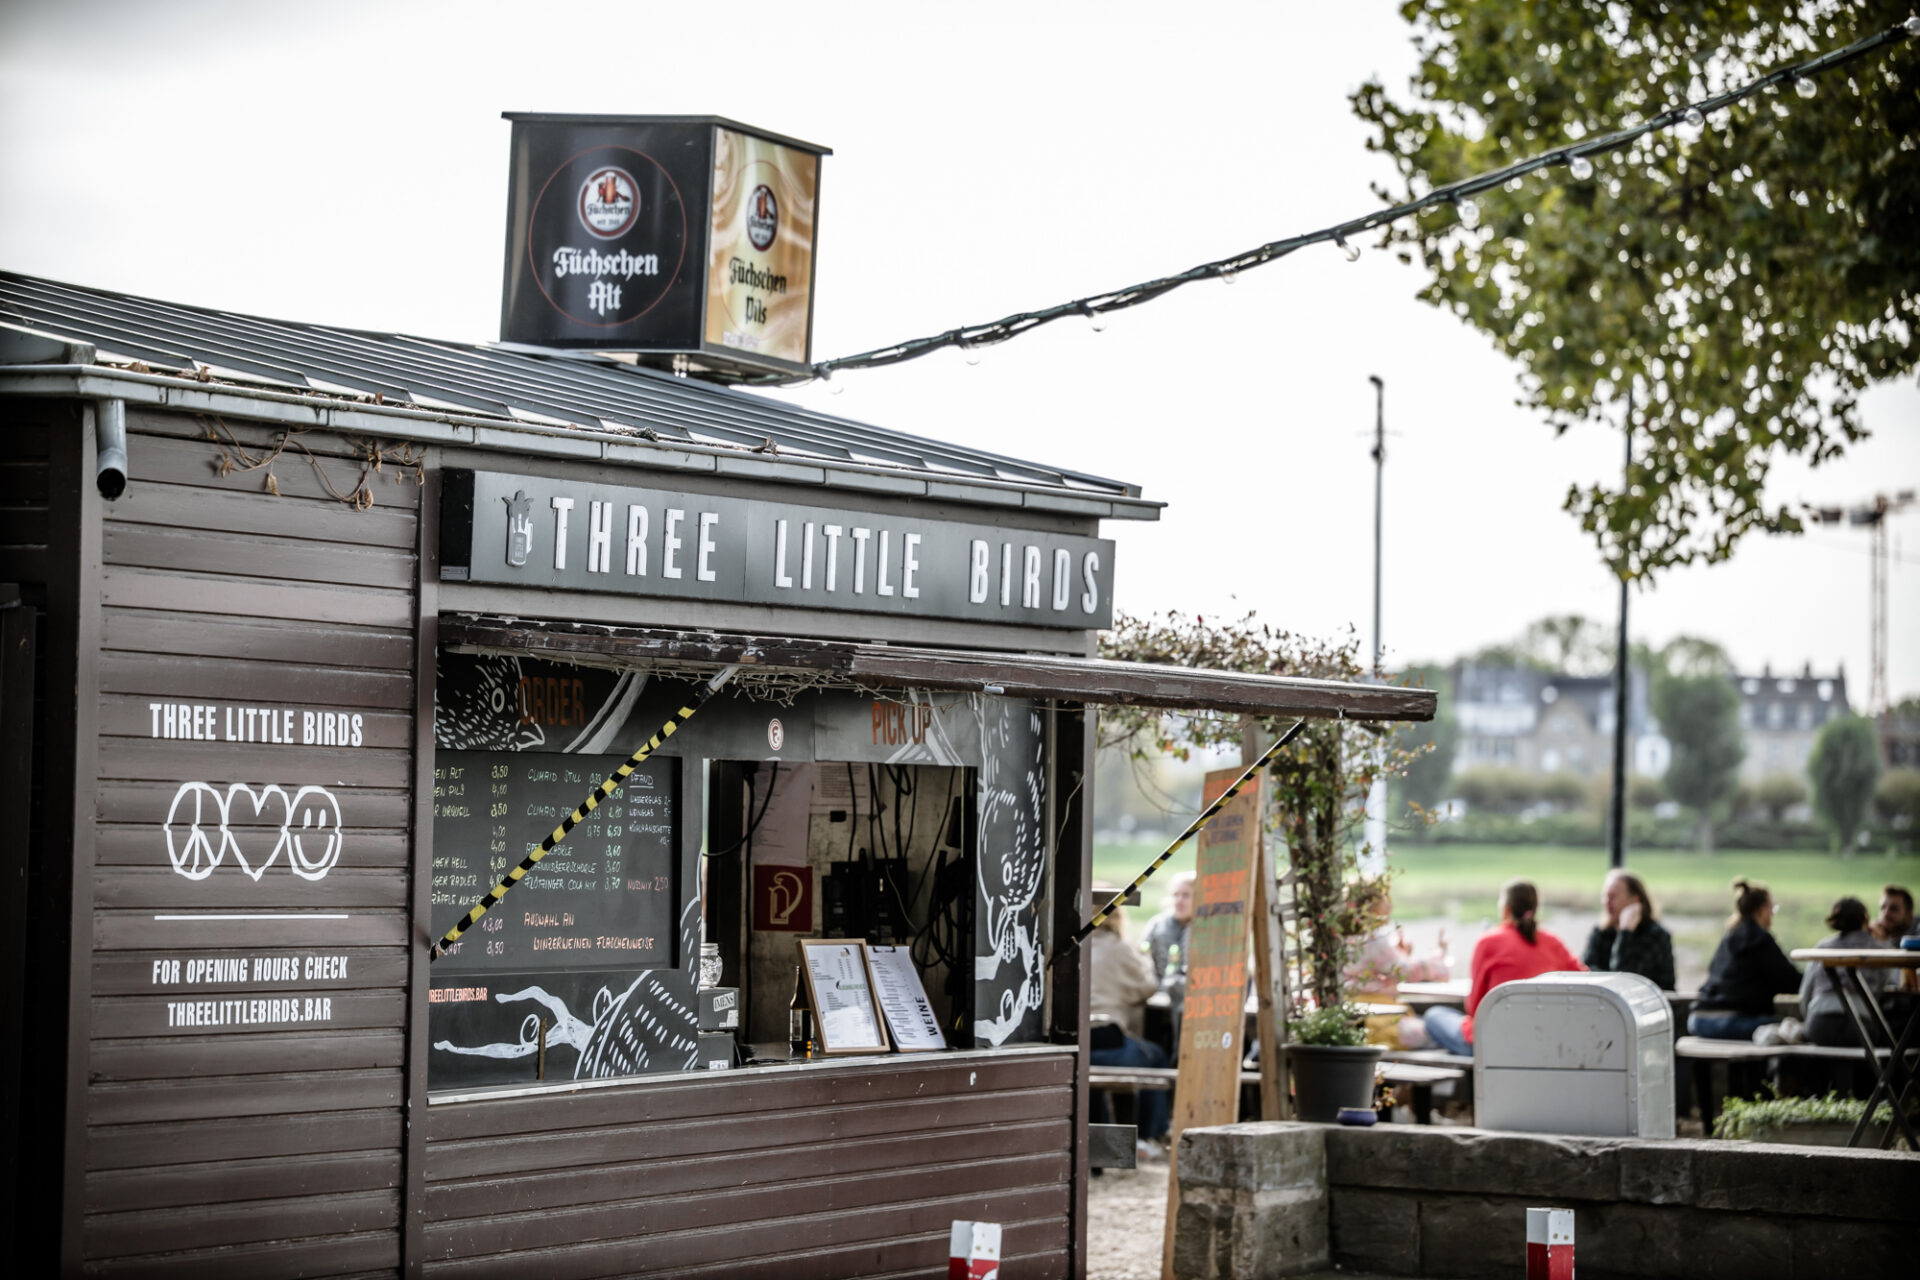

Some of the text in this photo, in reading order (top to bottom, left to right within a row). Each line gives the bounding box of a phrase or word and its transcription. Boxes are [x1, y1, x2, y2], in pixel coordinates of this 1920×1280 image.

[553, 246, 659, 282] Füchschen
[729, 256, 787, 296] Füchschen
[588, 281, 622, 317] Alt
[745, 297, 767, 325] Pils
[551, 496, 1099, 615] THREE LITTLE BIRDS
[519, 675, 585, 727] ORDER
[150, 703, 363, 747] THREE LITTLE BIRDS
[872, 701, 932, 746] PICK UP
[152, 956, 349, 985] FOR OPENING HOURS CHECK
[168, 998, 332, 1027] THREELITTLEBIRDS.BAR
[915, 996, 939, 1036] WEINE
